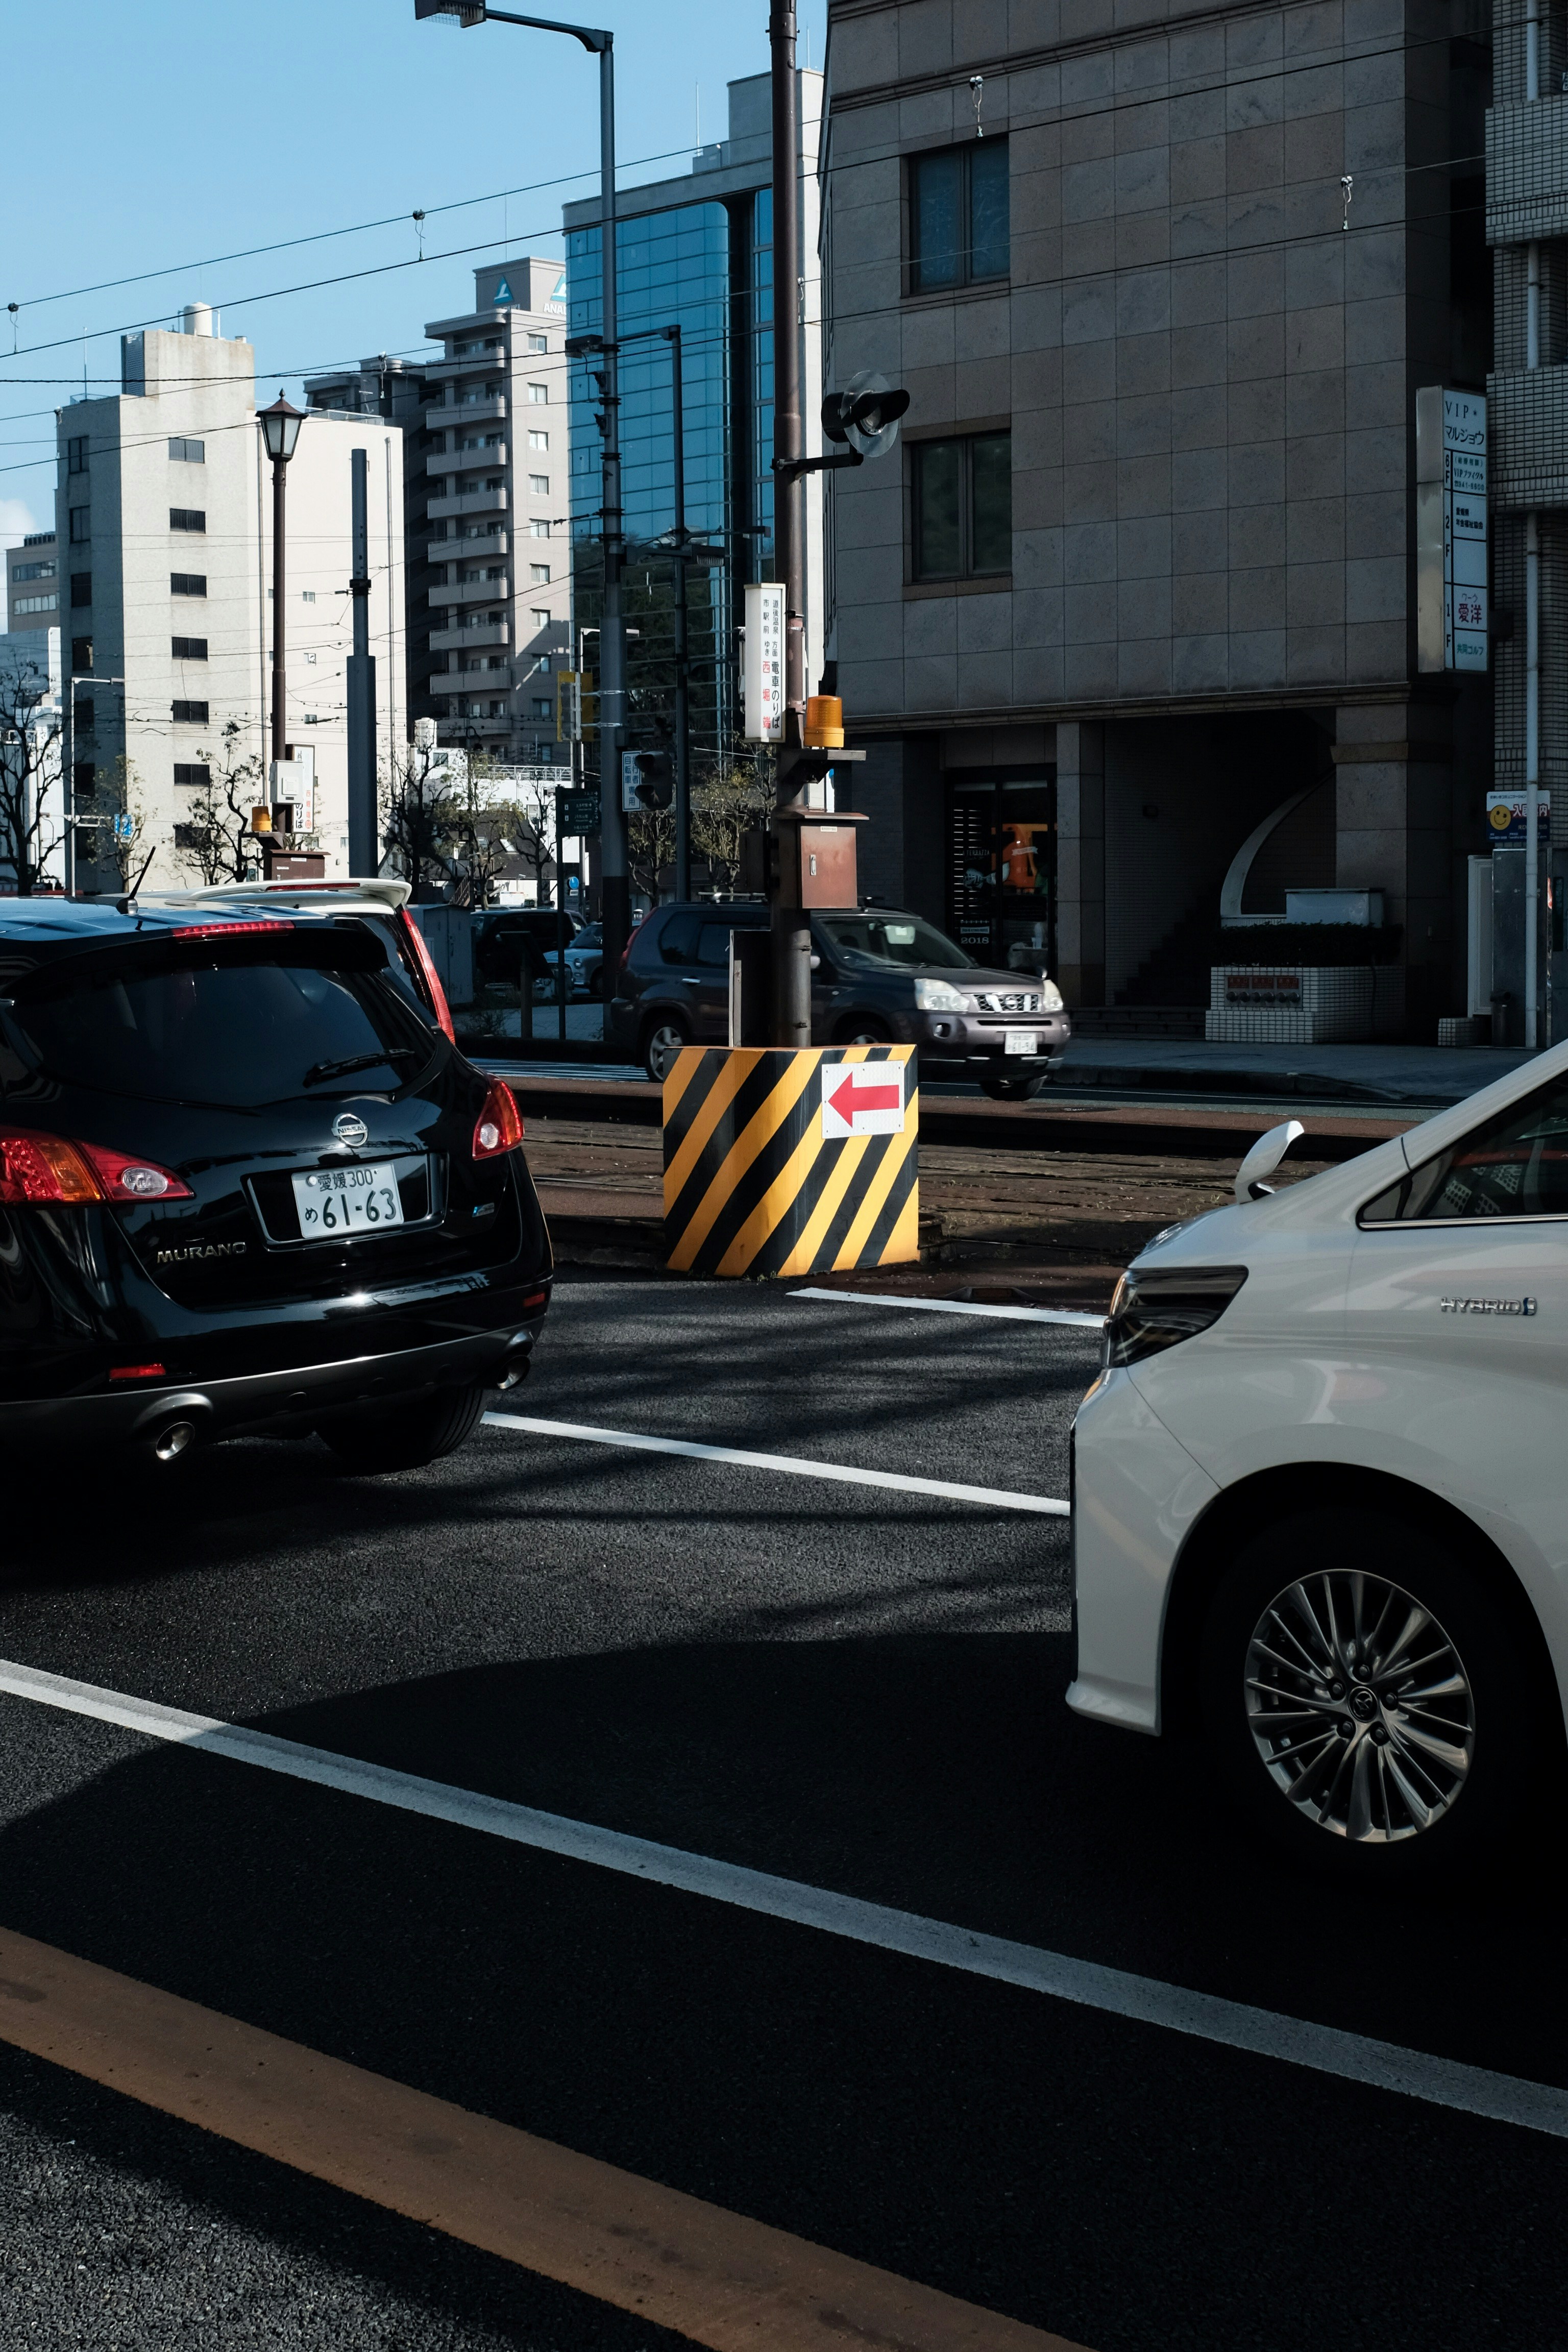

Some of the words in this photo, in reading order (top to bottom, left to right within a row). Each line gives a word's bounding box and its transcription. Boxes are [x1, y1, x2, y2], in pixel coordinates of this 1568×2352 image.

[1445, 401, 1468, 419] VIP
[1445, 426, 1484, 445] マルジョウ
[1458, 603, 1482, 624] 愛洋
[764, 641, 770, 657] ゆき
[772, 641, 778, 657] 方面
[763, 660, 771, 729] 西堀端
[771, 661, 780, 729] 電車のりば
[1513, 803, 1548, 817] 入居内
[305, 1207, 318, 1223] め
[323, 1188, 397, 1229] 61-63
[157, 1241, 247, 1264] MURANO
[1440, 1296, 1522, 1315] HYBRID
